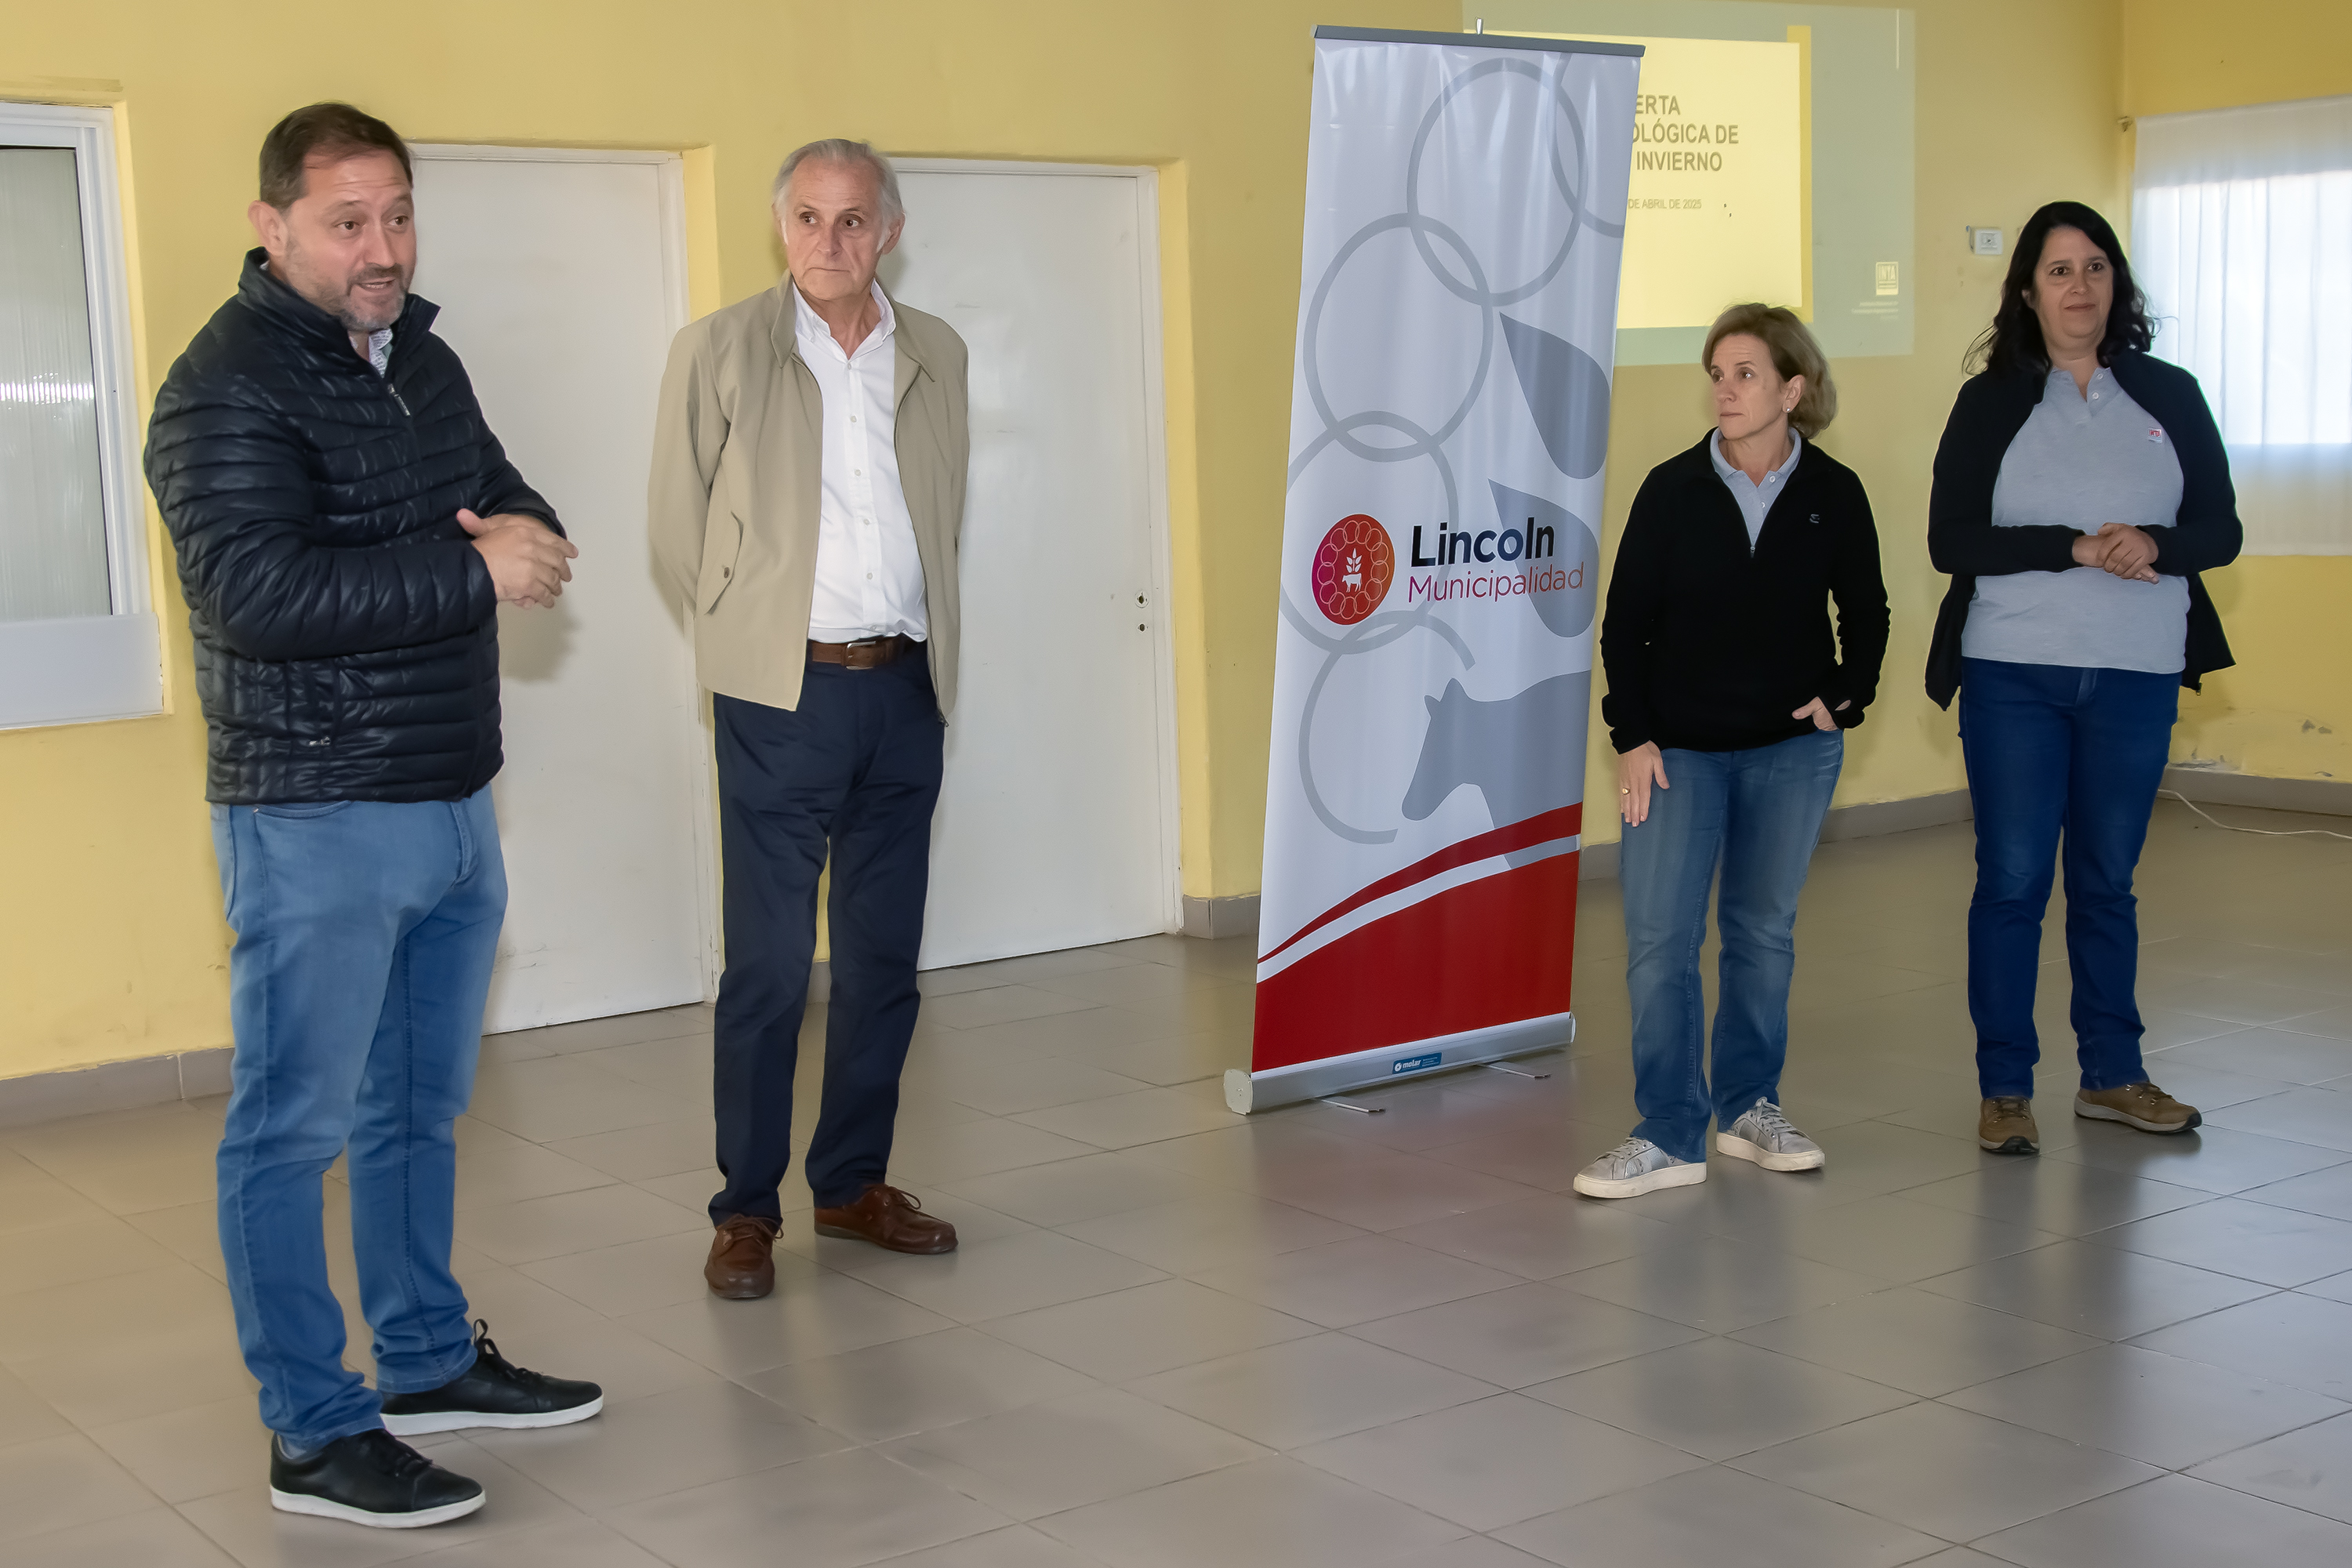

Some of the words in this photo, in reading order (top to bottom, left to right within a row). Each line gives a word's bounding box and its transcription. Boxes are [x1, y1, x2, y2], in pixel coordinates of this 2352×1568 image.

[1635, 94, 1681, 115] ERTA
[1715, 124, 1739, 144] DE
[1636, 151, 1722, 172] INVIERNO
[1628, 198, 1640, 209] DE
[1642, 198, 1667, 209] ABRIL
[1668, 198, 1681, 209] DE
[1682, 198, 1702, 209] 2025
[1410, 516, 1555, 568] Lincoln
[1408, 561, 1584, 603] Municipalidad
